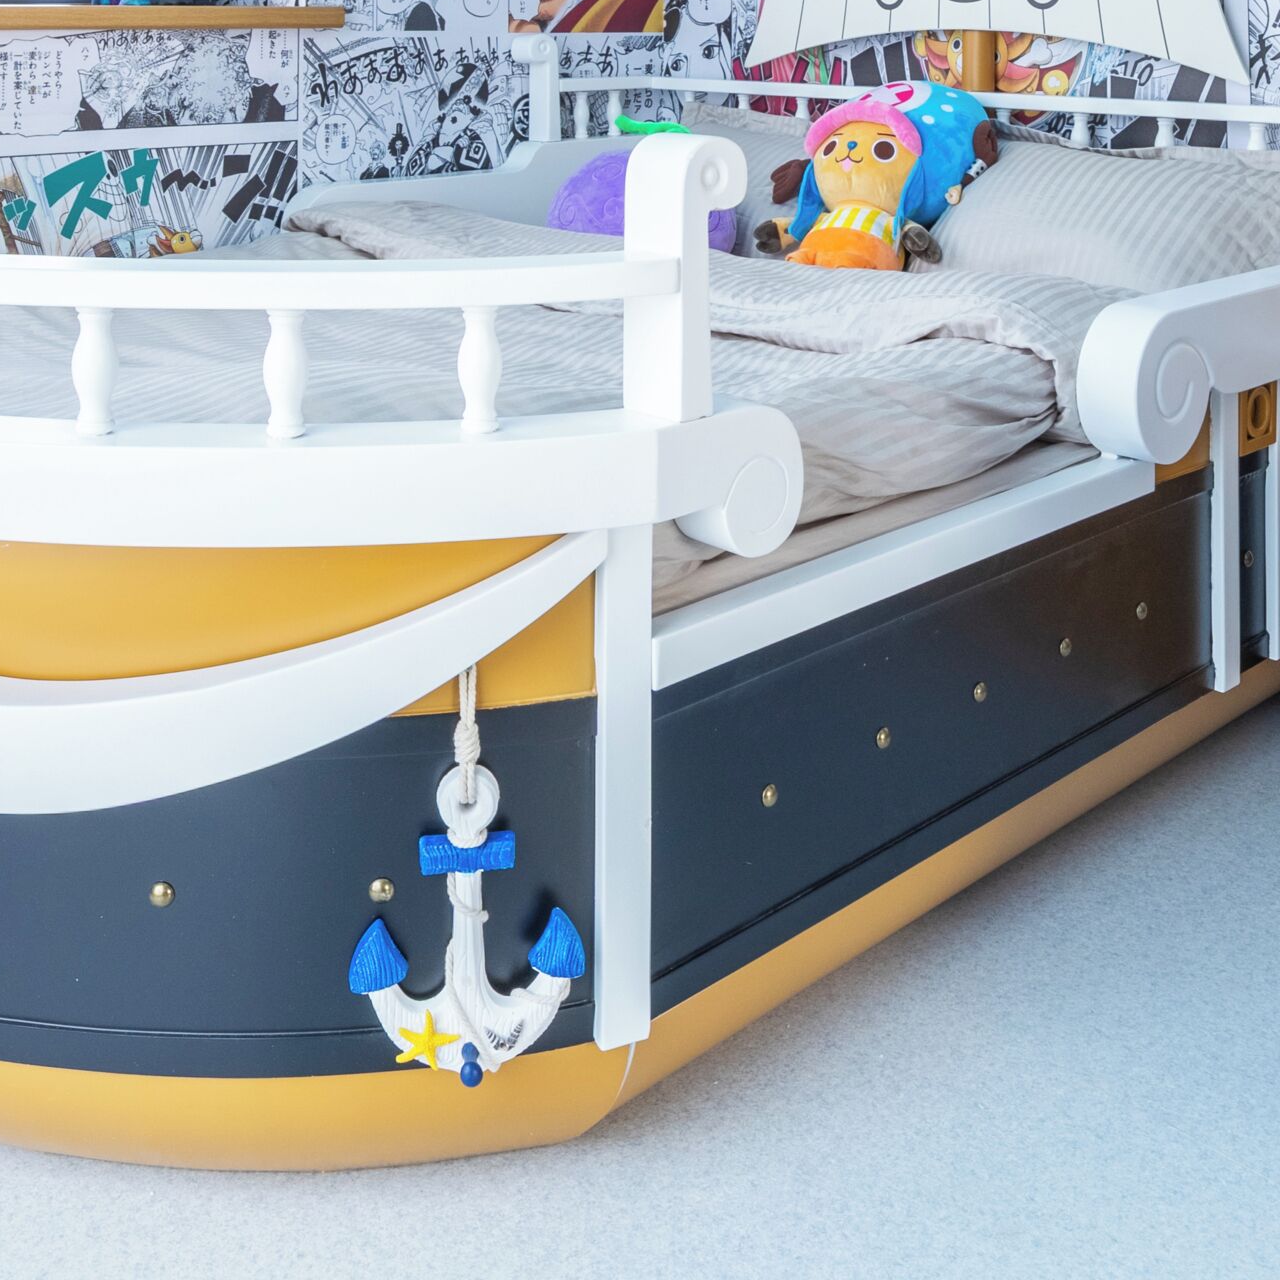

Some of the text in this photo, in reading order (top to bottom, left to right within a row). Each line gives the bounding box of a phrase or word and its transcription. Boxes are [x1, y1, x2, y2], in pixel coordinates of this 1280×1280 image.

[41, 49, 52, 100] ジンベエが
